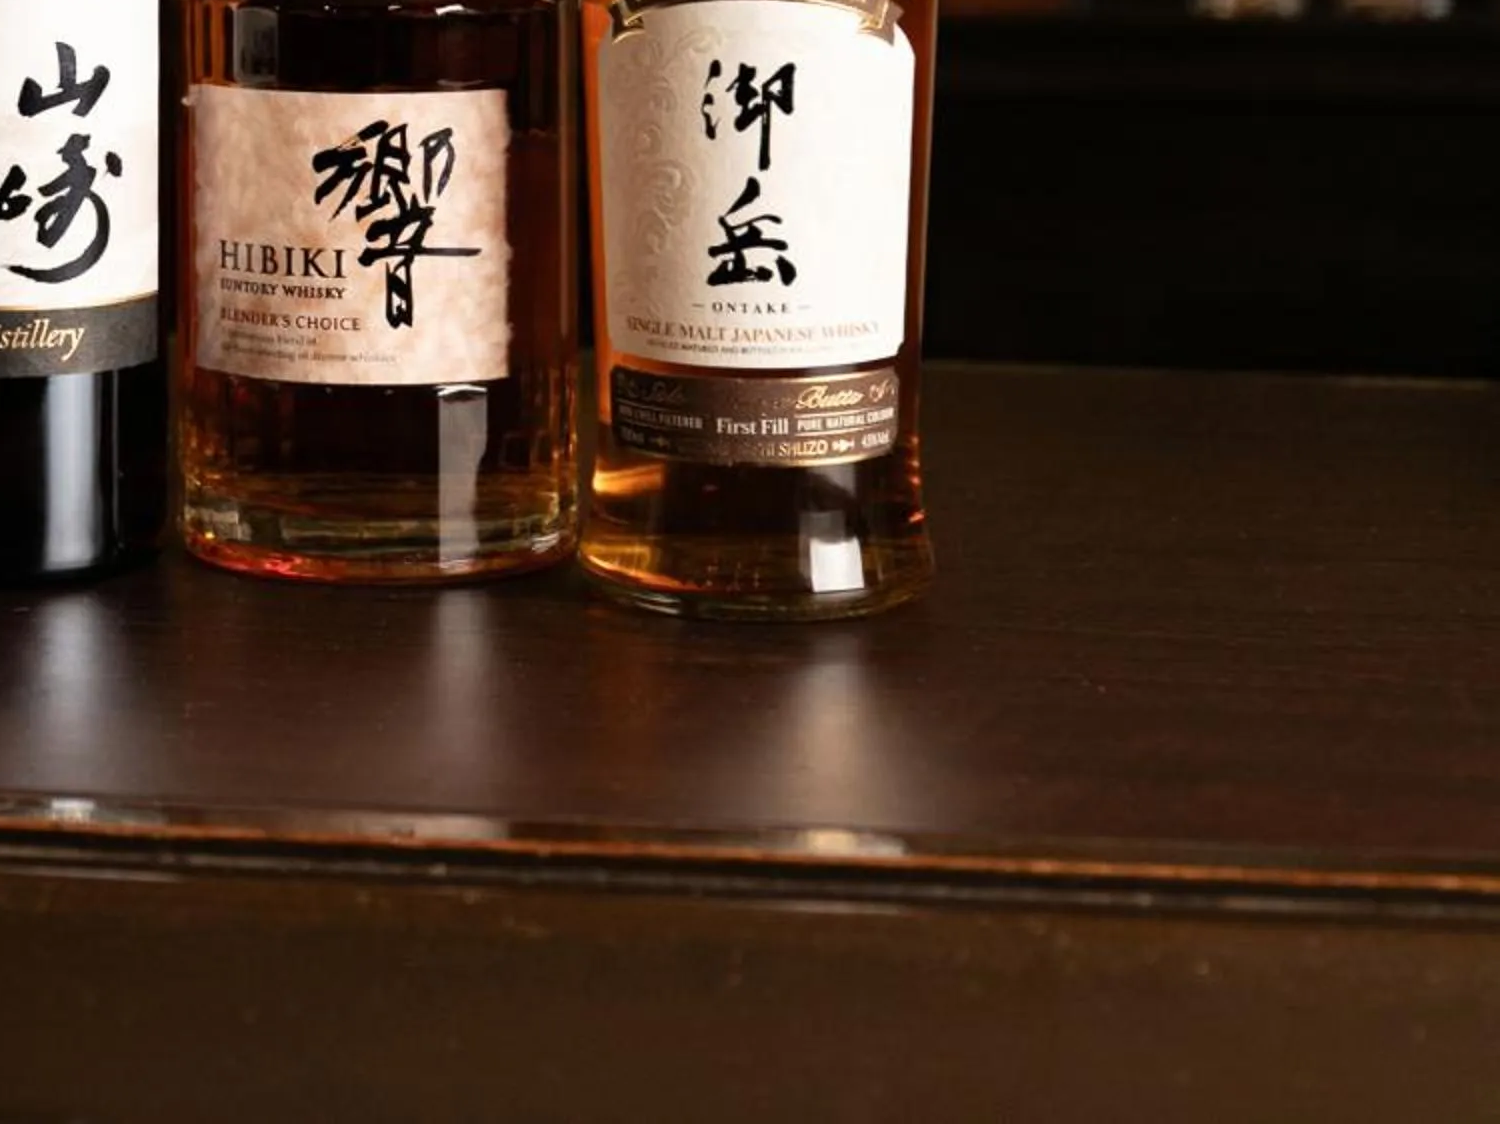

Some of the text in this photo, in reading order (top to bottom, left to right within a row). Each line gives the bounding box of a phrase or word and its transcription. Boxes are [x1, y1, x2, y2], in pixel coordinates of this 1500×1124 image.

[312, 119, 482, 330] 響
[220, 240, 348, 279] HIBIKI
[220, 277, 347, 300] SUNTORY WHISKY
[220, 307, 362, 332] BLENDER'S CHOICE
[711, 302, 792, 314] ONTAKE
[680, 325, 726, 341] MALT
[731, 325, 815, 344] JAPANESE
[716, 417, 789, 436] First Fill
